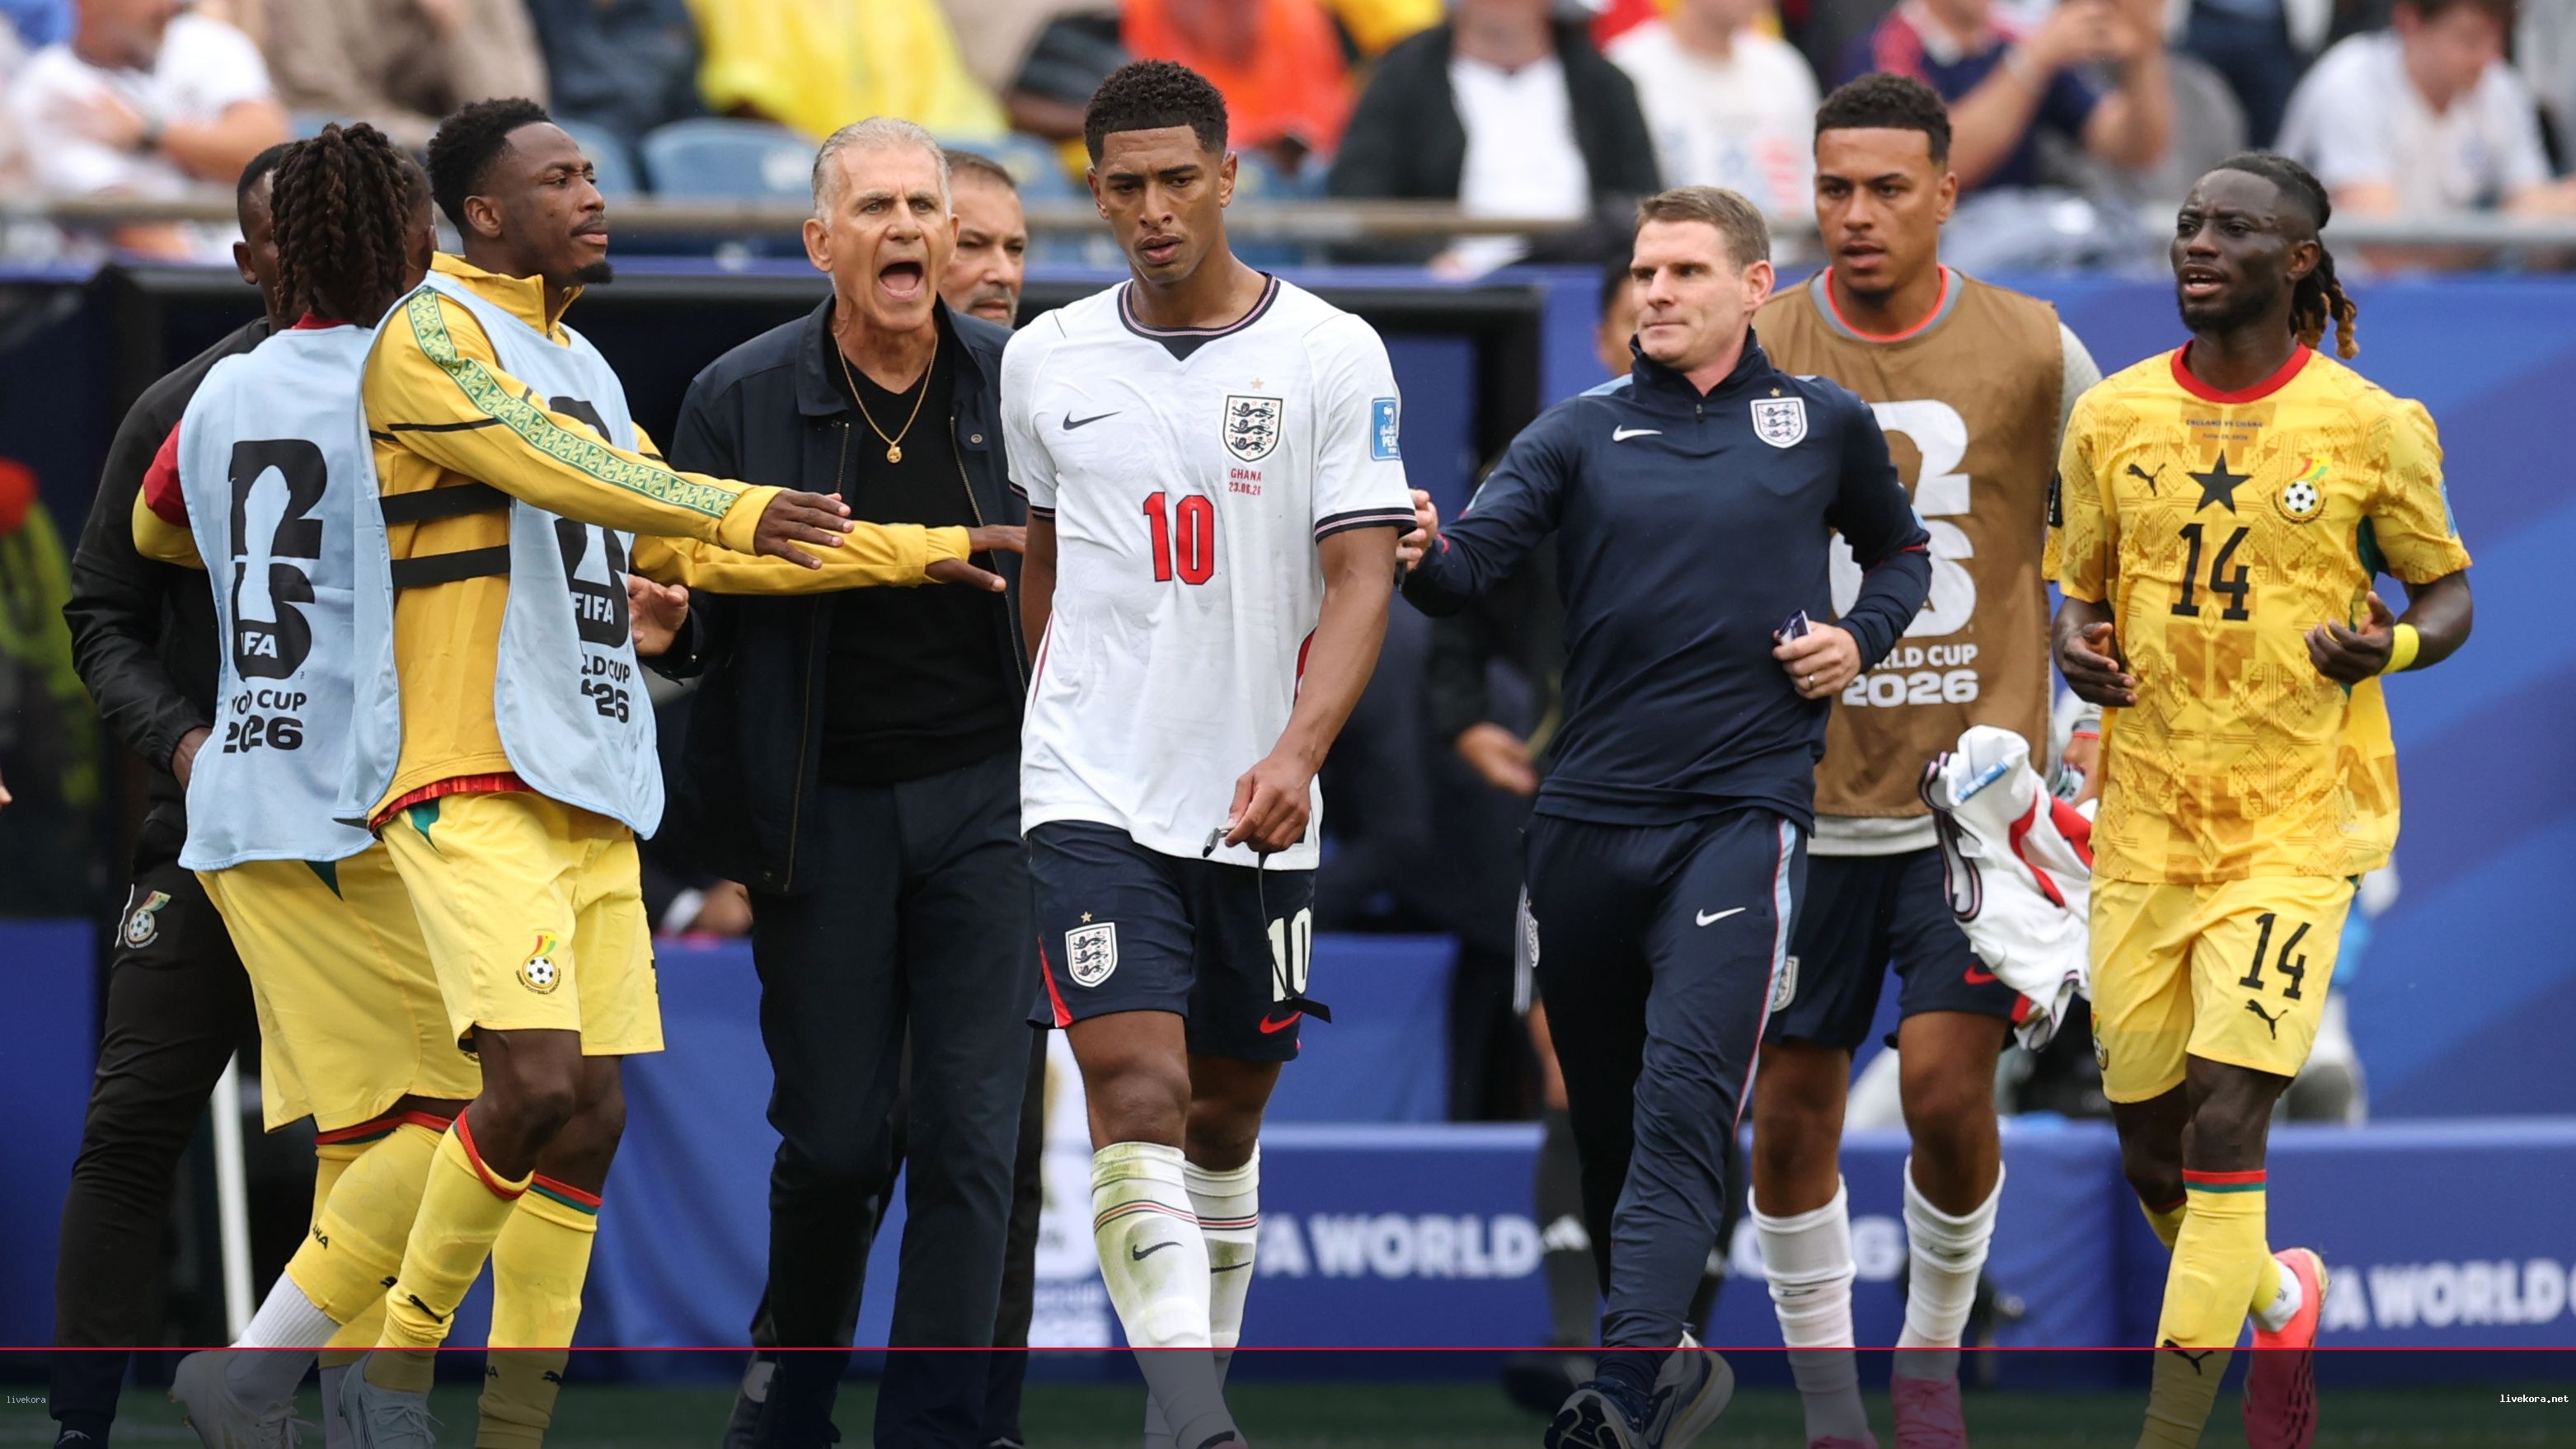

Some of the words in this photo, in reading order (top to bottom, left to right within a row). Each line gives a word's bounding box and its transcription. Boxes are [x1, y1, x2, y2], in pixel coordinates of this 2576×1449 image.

[1231, 467, 1261, 481] GHANA
[1143, 491, 1214, 586] 10
[2170, 523, 2250, 621] 14
[608, 659, 631, 683] CUP
[1842, 668, 1979, 708] 2026
[1926, 643, 1978, 667] CUP
[256, 689, 307, 711] CUP
[1267, 907, 1311, 1002] 10
[2238, 912, 2312, 1001] 14
[1309, 1213, 1544, 1279] WORLD
[2367, 1258, 2566, 1329] WORLD
